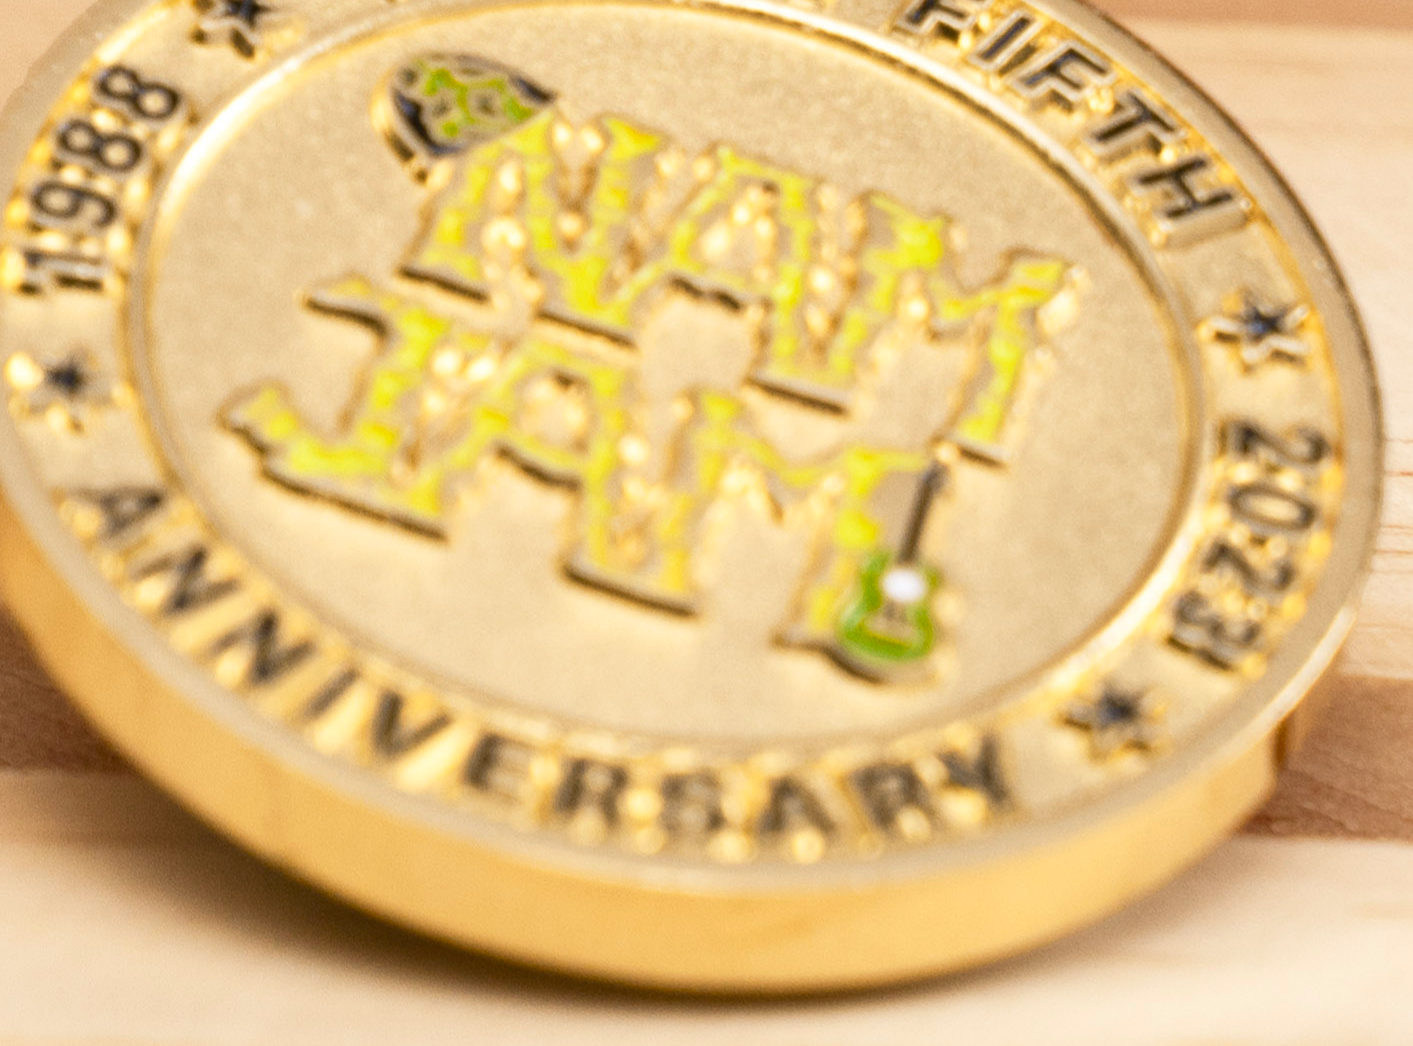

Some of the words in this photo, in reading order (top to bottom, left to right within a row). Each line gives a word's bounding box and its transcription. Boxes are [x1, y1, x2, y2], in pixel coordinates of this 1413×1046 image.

[18, 64, 181, 291] 1988
[398, 112, 1078, 466] NAM
[218, 279, 940, 648] JAM
[1171, 418, 1331, 660] 2023
[68, 487, 1016, 832] ANNIVERSARY
